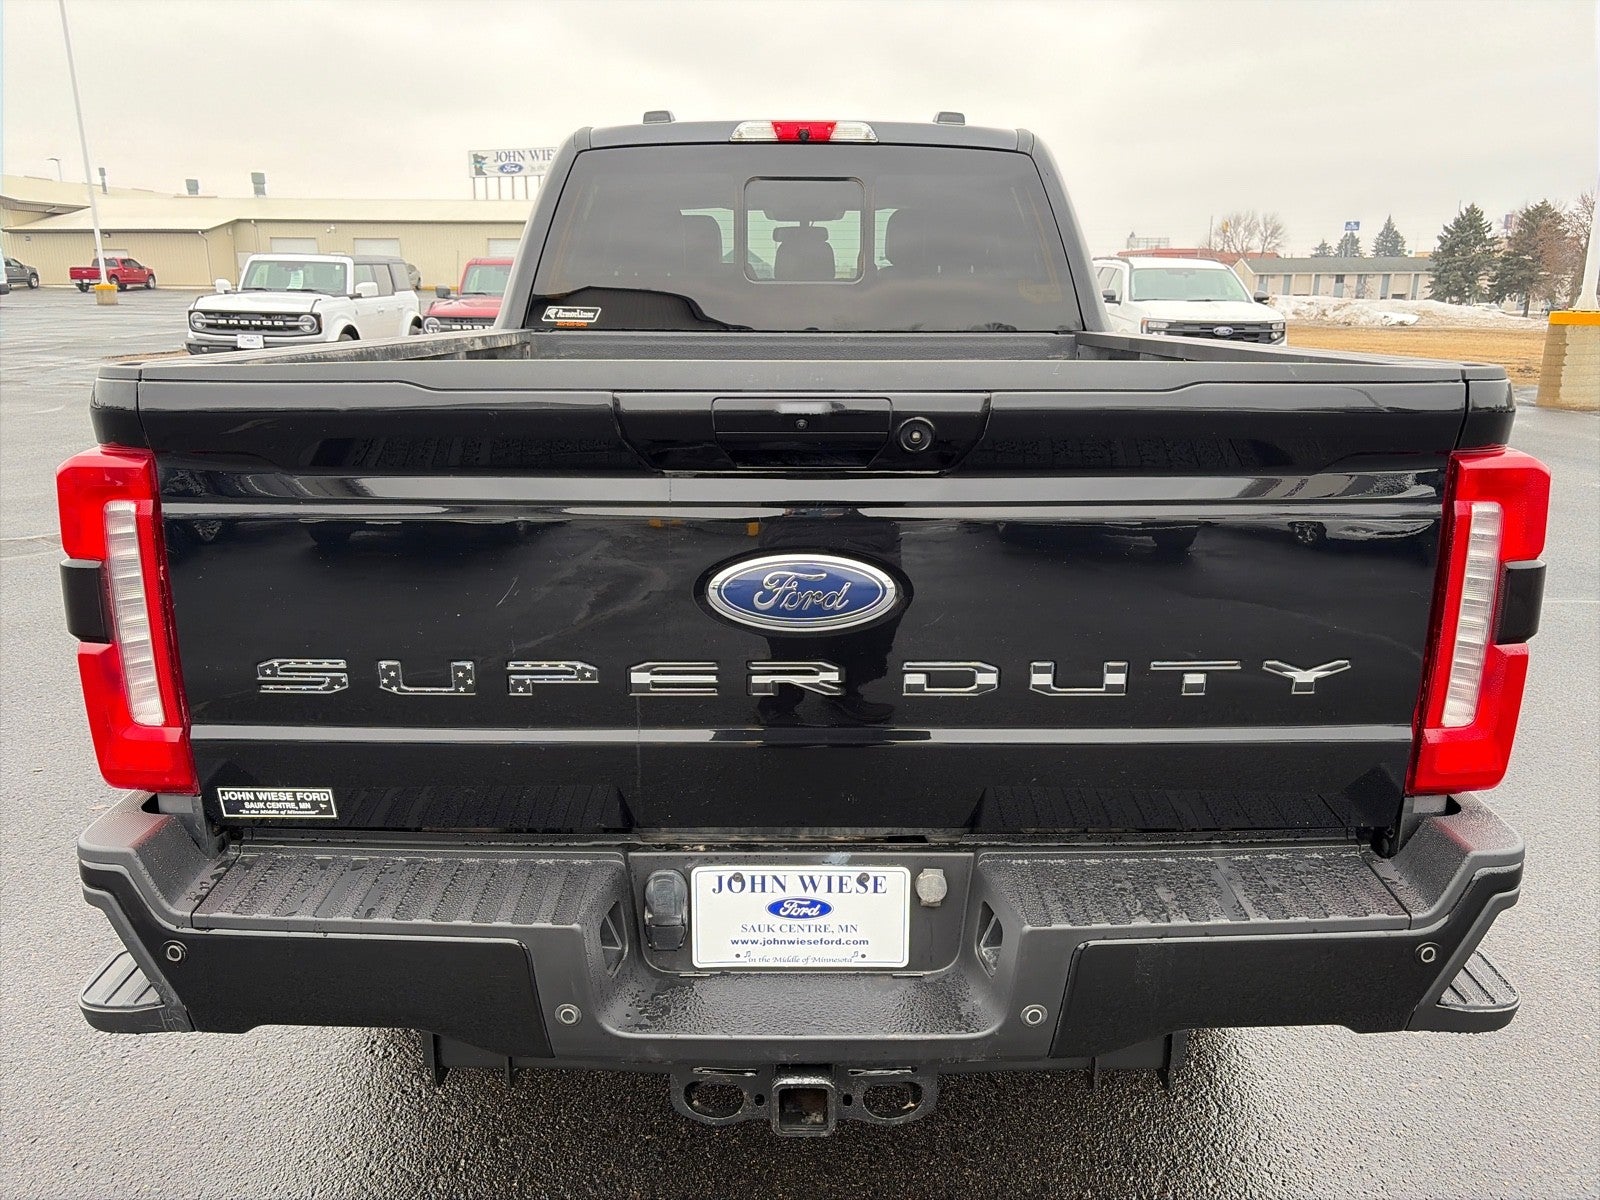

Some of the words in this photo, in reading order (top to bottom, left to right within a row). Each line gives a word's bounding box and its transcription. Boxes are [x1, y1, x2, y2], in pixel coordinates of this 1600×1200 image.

[494, 151, 525, 162] JOHN
[753, 570, 852, 611] Ford
[256, 659, 844, 696] SUPER
[902, 659, 1352, 696] DUTY
[222, 791, 254, 801] JOHN
[256, 791, 294, 801] WIESE
[296, 792, 329, 801] FORD
[712, 874, 787, 894] JOHN
[800, 874, 887, 894] WIESE
[779, 899, 821, 917] Ford
[741, 924, 775, 933] SAUK
[779, 924, 834, 934] CENTRE,
[837, 924, 858, 933] MN
[731, 937, 869, 946] www.johnwieseford.com
[758, 955, 770, 963] the
[772, 955, 800, 963] Middle
[801, 955, 810, 965] of
[811, 955, 852, 963] Minnesota
